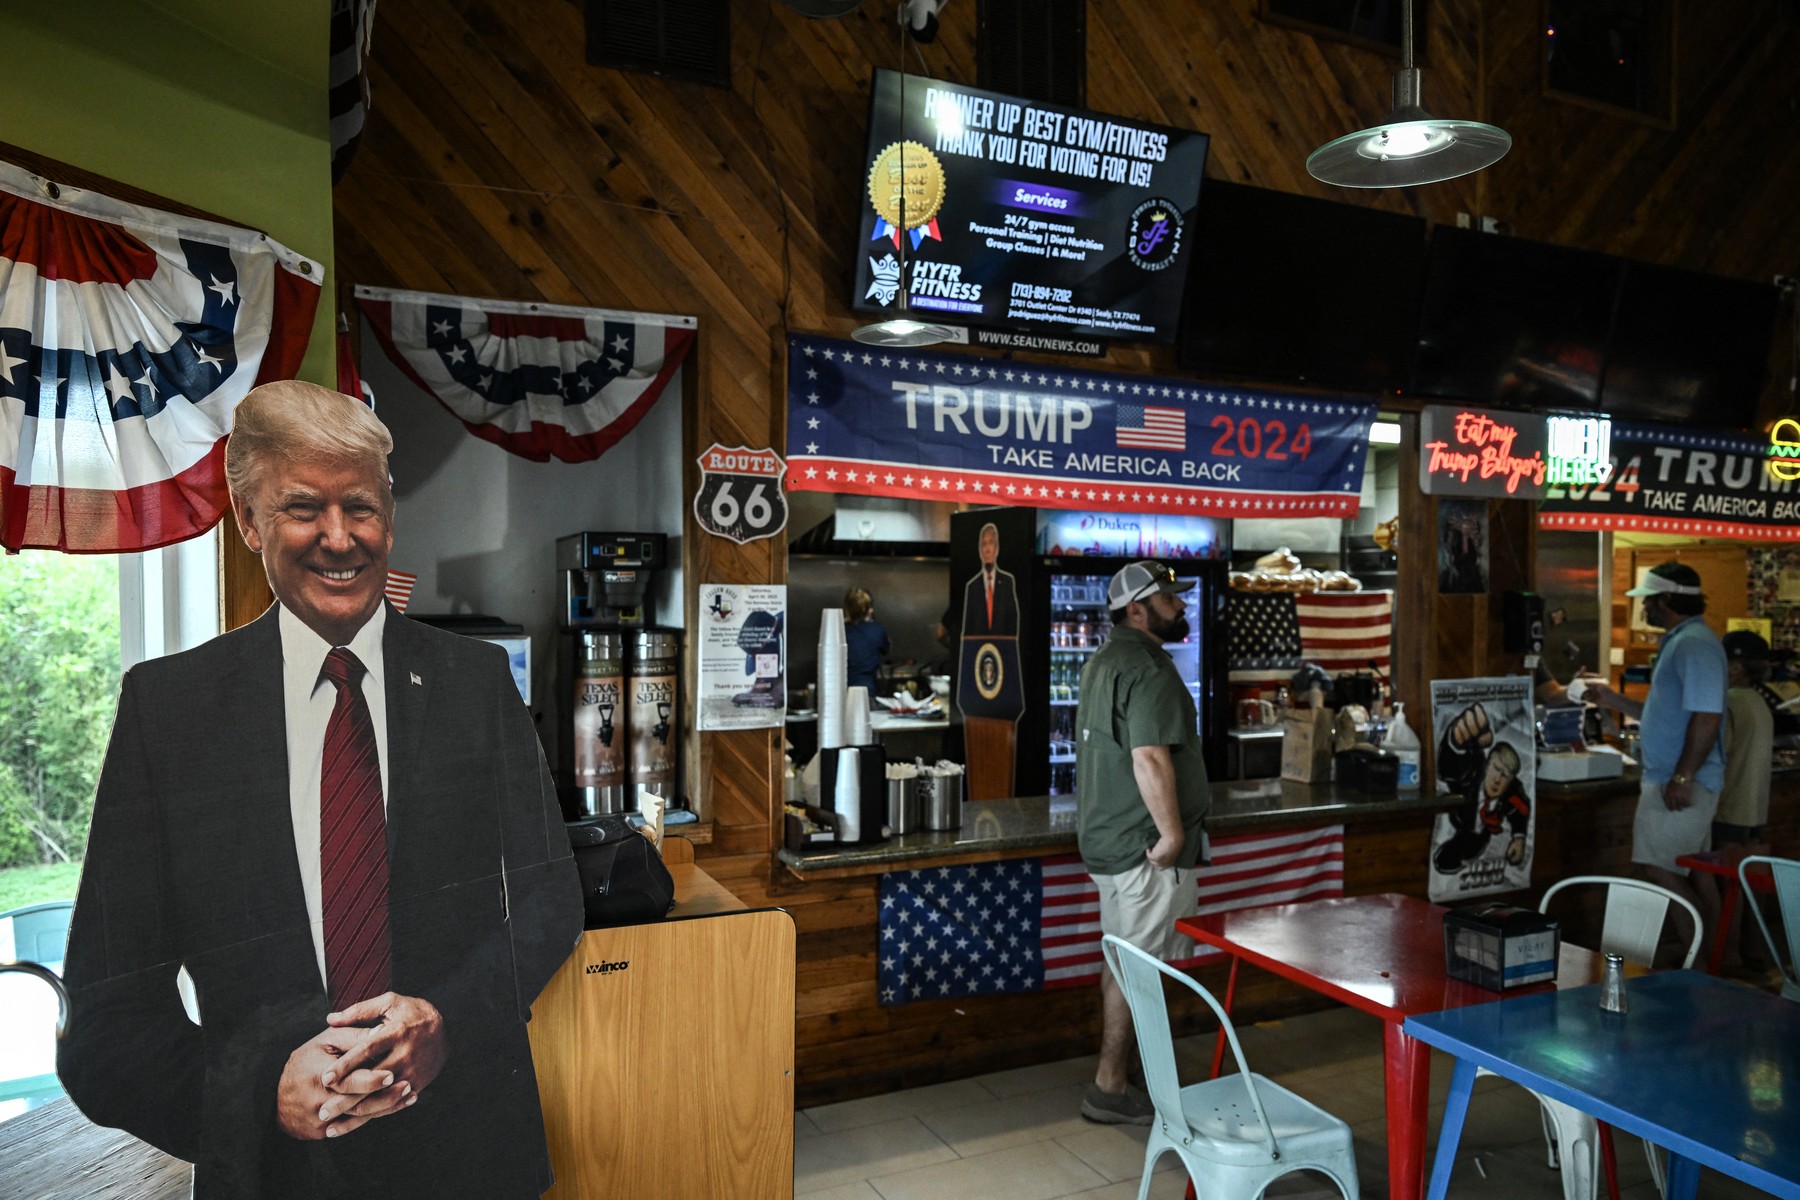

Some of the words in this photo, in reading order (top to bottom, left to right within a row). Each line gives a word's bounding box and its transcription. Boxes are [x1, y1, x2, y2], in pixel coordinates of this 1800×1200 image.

[996, 103, 1021, 133] UP
[1023, 108, 1064, 142] BEST
[1066, 117, 1168, 162] GYM/FITNESS
[988, 134, 1018, 165] YOU
[1019, 141, 1048, 169] FOR
[1050, 145, 1099, 178] VOTING
[1100, 155, 1128, 183] FOR
[1129, 162, 1153, 187] US!
[1014, 188, 1068, 209] Services
[1004, 213, 1029, 228] 24/7
[1028, 219, 1048, 231] gym
[1048, 222, 1075, 234] access
[969, 222, 1008, 237] Personal
[1008, 228, 1043, 244] Training
[1049, 233, 1067, 245] Diet
[1067, 236, 1104, 251] Nutrition
[985, 237, 1013, 253] Group
[1014, 241, 1045, 255] Classes
[912, 260, 962, 282] HYFR
[910, 277, 982, 301] FITNESS
[978, 331, 1100, 355] WWW.SEALYNEWS.COM
[891, 380, 1093, 445] TRUMP
[1210, 413, 1313, 461] 2024
[1455, 412, 1494, 447] Eat
[1489, 425, 1518, 459] my
[709, 453, 775, 473] ROUTE
[987, 444, 1054, 469] TAKE
[1064, 452, 1172, 477] AMERICA
[1181, 460, 1242, 482] BACK
[1425, 441, 1479, 483] Trump
[1479, 445, 1547, 494] Burger's
[1546, 456, 1598, 484] HERE
[711, 481, 773, 529] 66
[1643, 489, 1688, 511] TAKE
[1692, 494, 1767, 518] AMERICA
[1098, 517, 1141, 532] Dukers
[585, 681, 619, 694] TEXAS
[636, 691, 673, 705] SELECT
[638, 680, 673, 692] TEXAS
[582, 692, 620, 706] SELECT
[586, 960, 629, 974] winco
